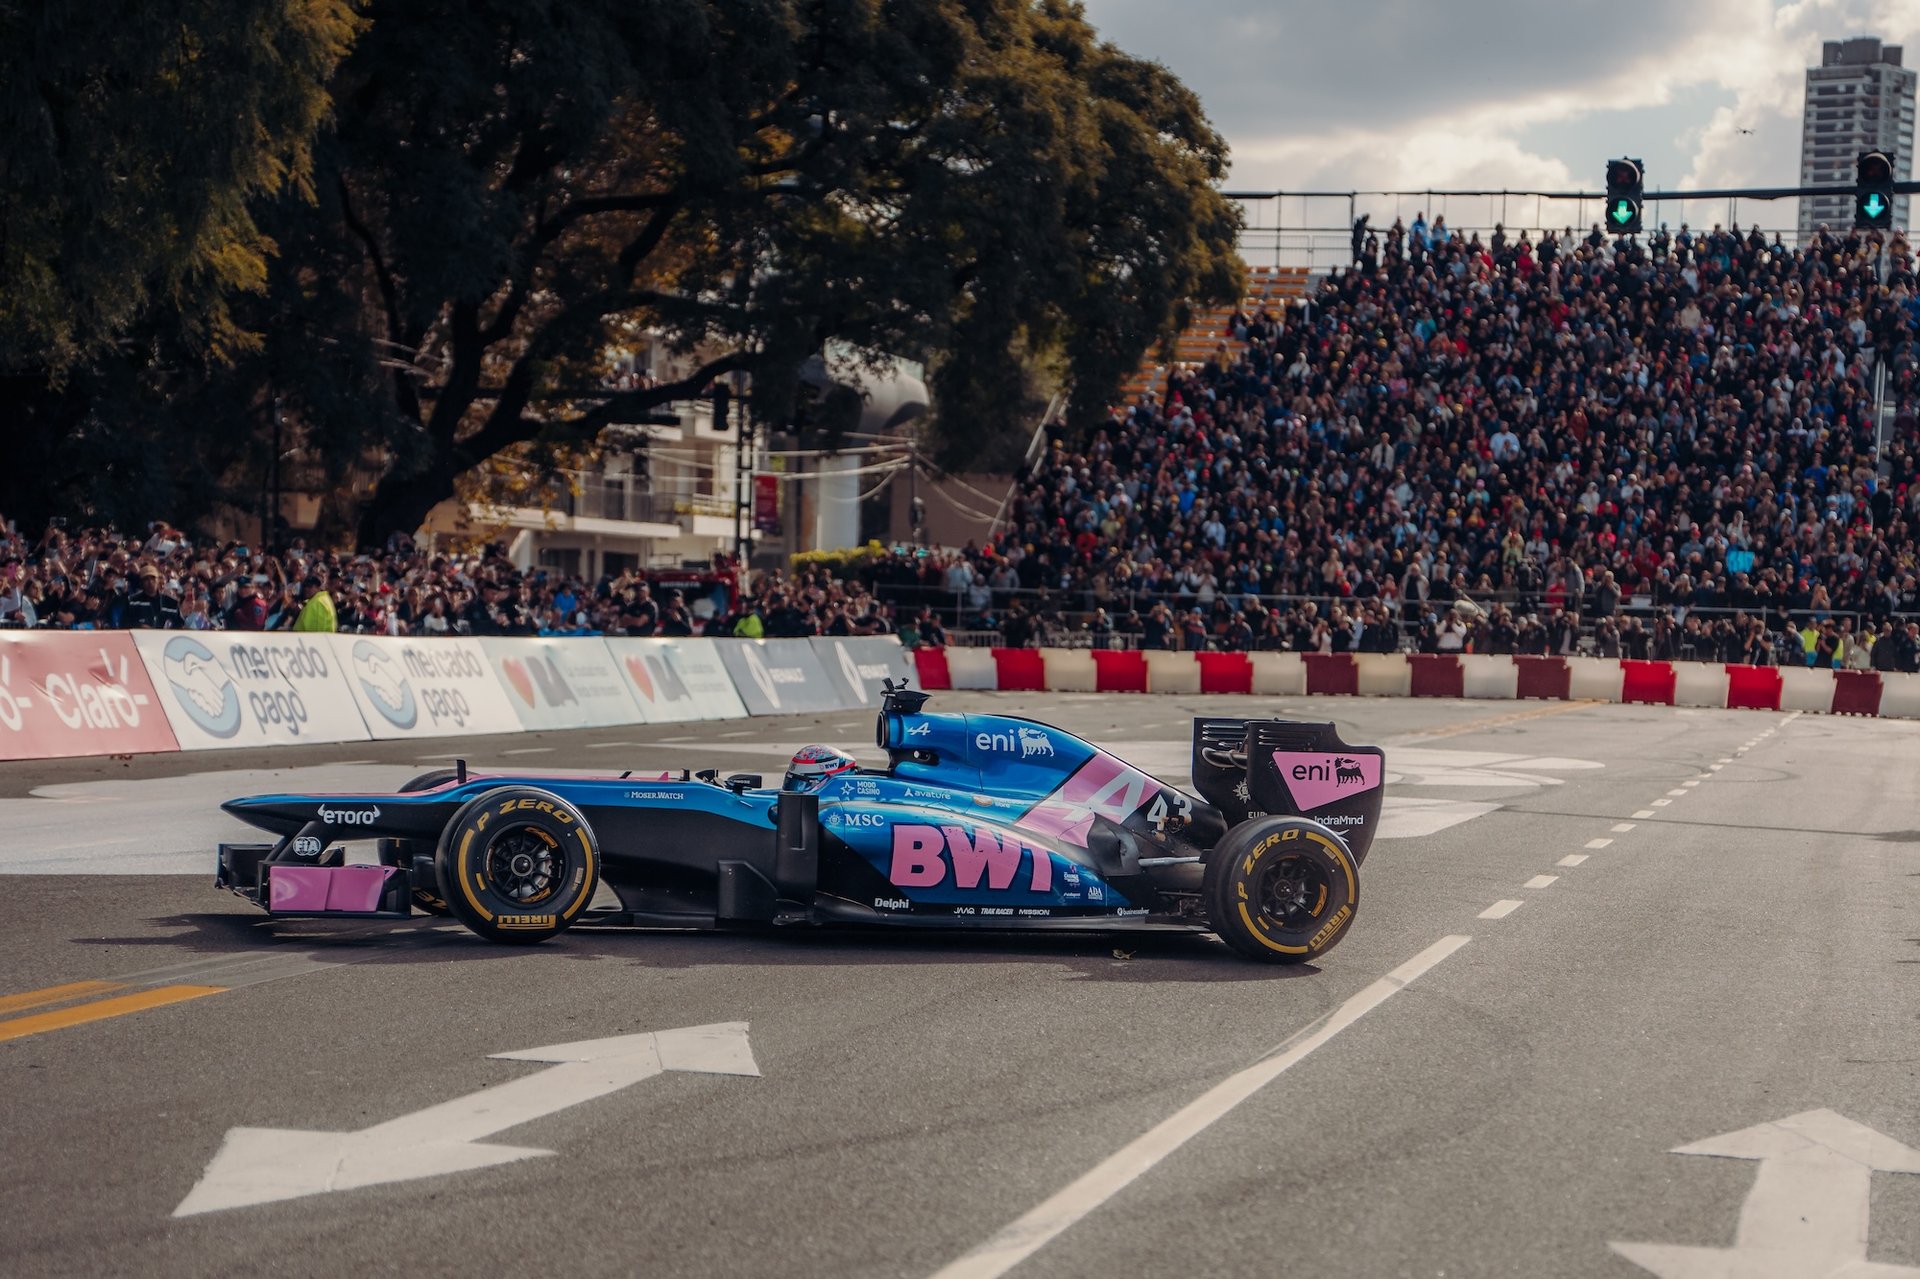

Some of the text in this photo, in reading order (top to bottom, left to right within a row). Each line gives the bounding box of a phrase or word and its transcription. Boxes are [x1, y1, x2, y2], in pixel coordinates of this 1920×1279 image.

[230, 637, 328, 680] mercado
[402, 642, 484, 678] mercado
[45, 669, 141, 730] Claro
[249, 689, 307, 736] pago
[422, 687, 471, 727] pago
[976, 729, 1015, 751] eni
[857, 780, 877, 788] MODO
[1292, 759, 1331, 781] eni
[857, 787, 881, 796] CASINO
[914, 791, 952, 800] avature
[476, 798, 574, 832] P ZERO
[844, 813, 885, 827] MSC
[1146, 794, 1193, 829] 43
[294, 840, 319, 853] FIA
[1237, 828, 1300, 900] P ZERO
[874, 897, 910, 910] Delphi
[497, 914, 557, 930] PIRELLI
[1309, 904, 1353, 952] PIRELLI
